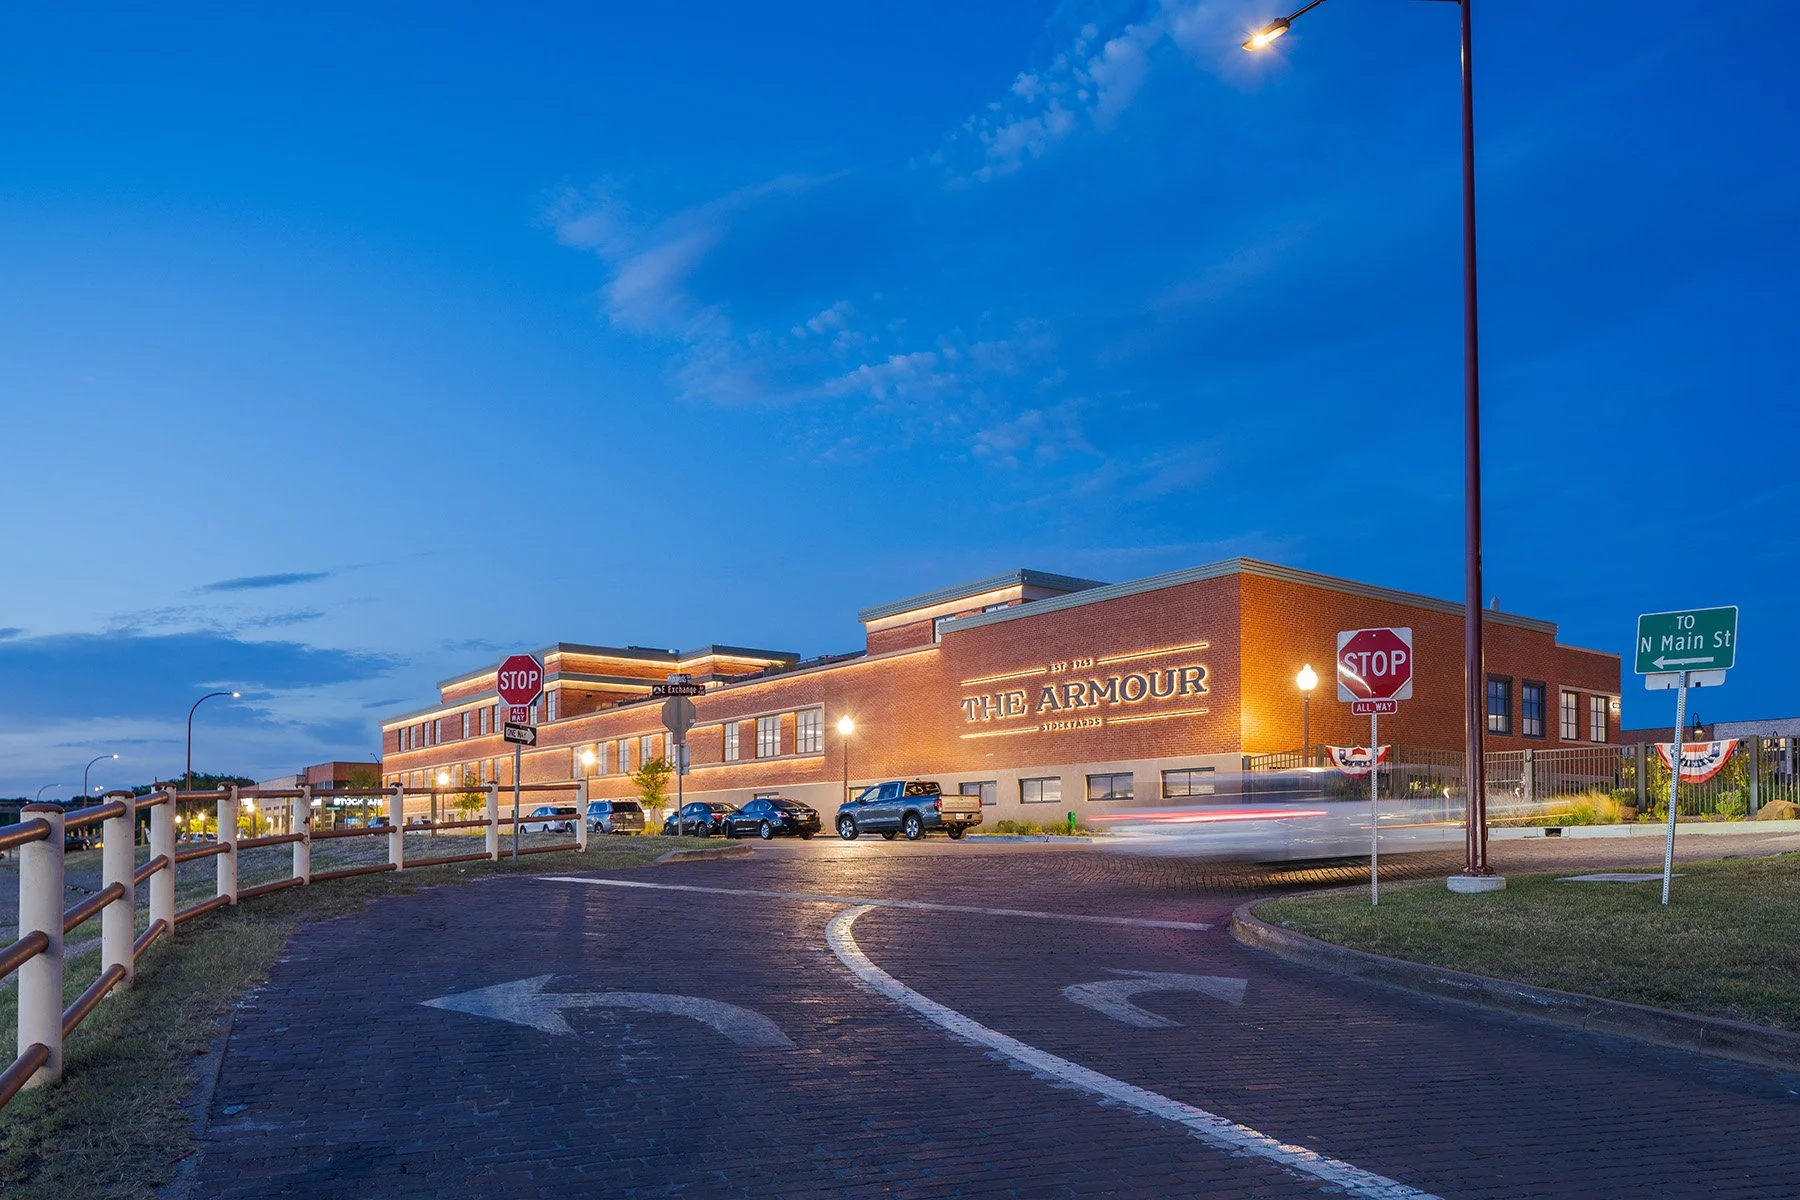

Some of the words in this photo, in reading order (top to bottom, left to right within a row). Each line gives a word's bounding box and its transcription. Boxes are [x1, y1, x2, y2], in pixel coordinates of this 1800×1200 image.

[1676, 615, 1695, 630] TO
[1641, 636, 1652, 653] N
[1661, 631, 1704, 652] Main
[1713, 630, 1731, 648] St
[1344, 650, 1407, 677] STOP
[500, 670, 538, 691] STOP
[661, 685, 666, 694] E
[668, 685, 697, 696] Exchange
[960, 690, 1026, 722] THE
[1035, 665, 1208, 713] ARMOUR
[1356, 704, 1372, 712] ALL
[1375, 703, 1393, 712] WAY
[1040, 718, 1100, 731] STOCKYARDS
[506, 728, 516, 738] ONE
[517, 729, 527, 739] WAY
